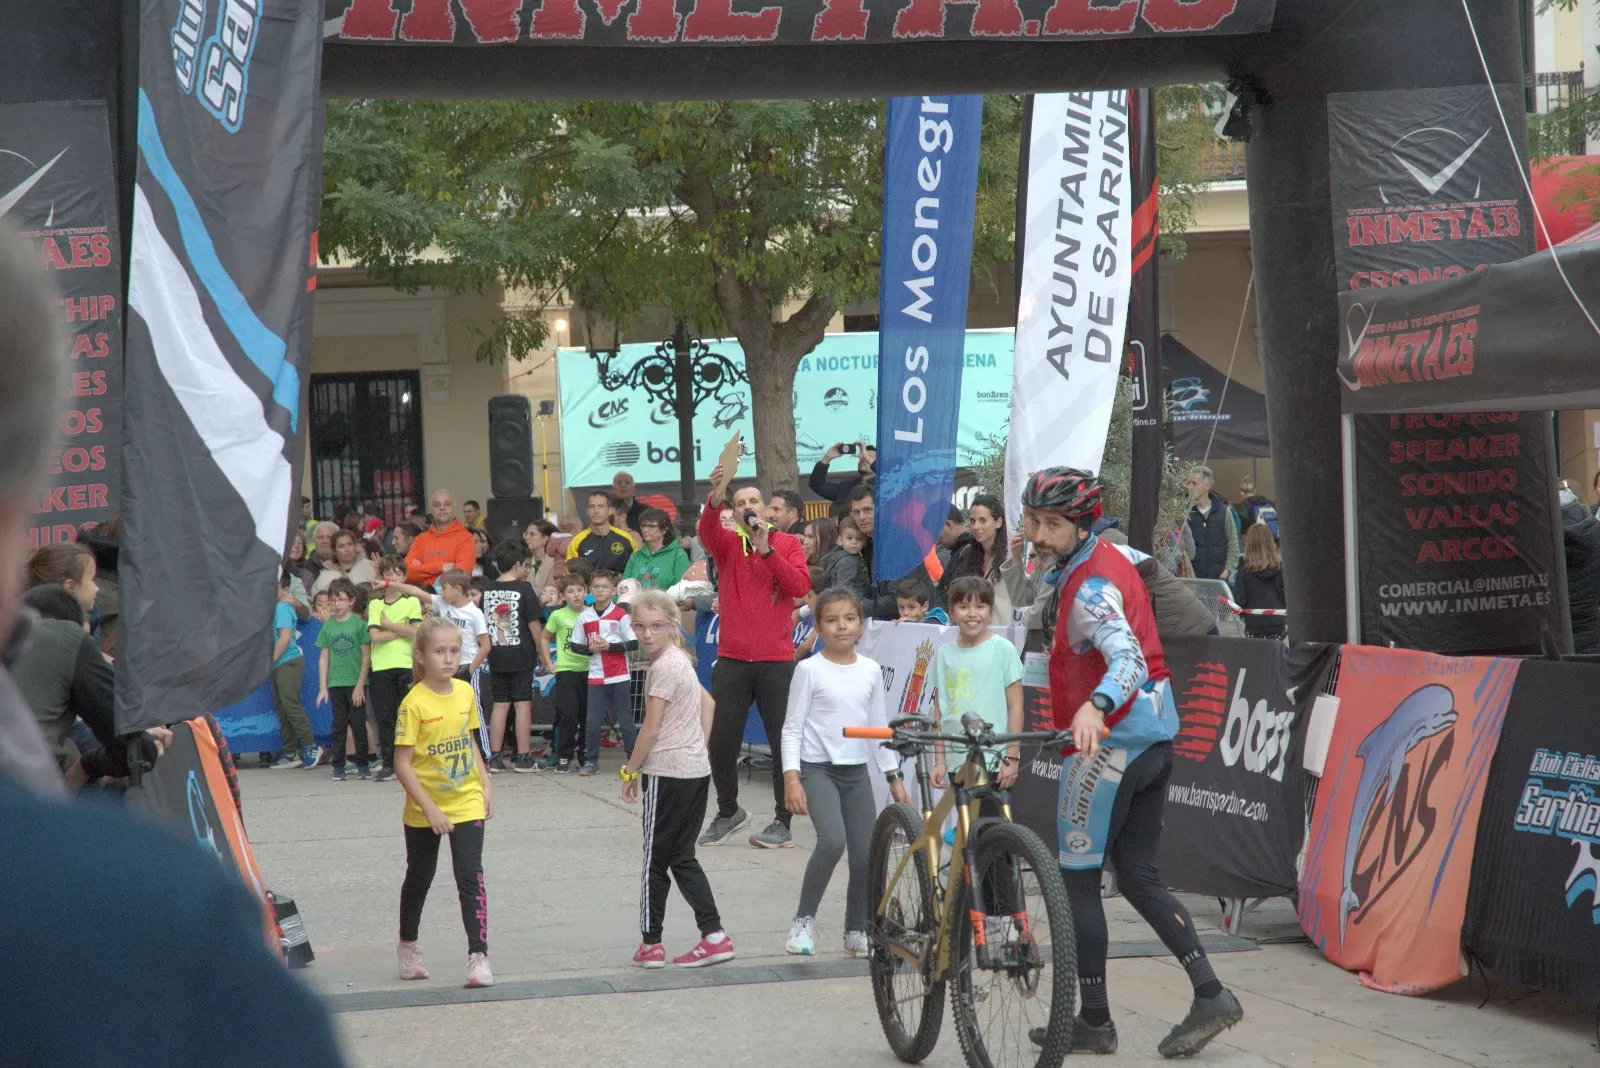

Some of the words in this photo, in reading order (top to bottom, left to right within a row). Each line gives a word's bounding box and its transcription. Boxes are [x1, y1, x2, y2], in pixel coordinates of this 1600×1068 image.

[1083, 291, 1116, 364] DE
[1390, 433, 1521, 464] SPEAKER
[1401, 468, 1518, 496] SONIDO
[1404, 501, 1520, 530] VALLAS
[1416, 535, 1520, 564] ARCOS
[1380, 591, 1553, 617] WWW.INMETA.ES
[445, 751, 471, 779] 71
[1515, 782, 1600, 839] Sariñe
